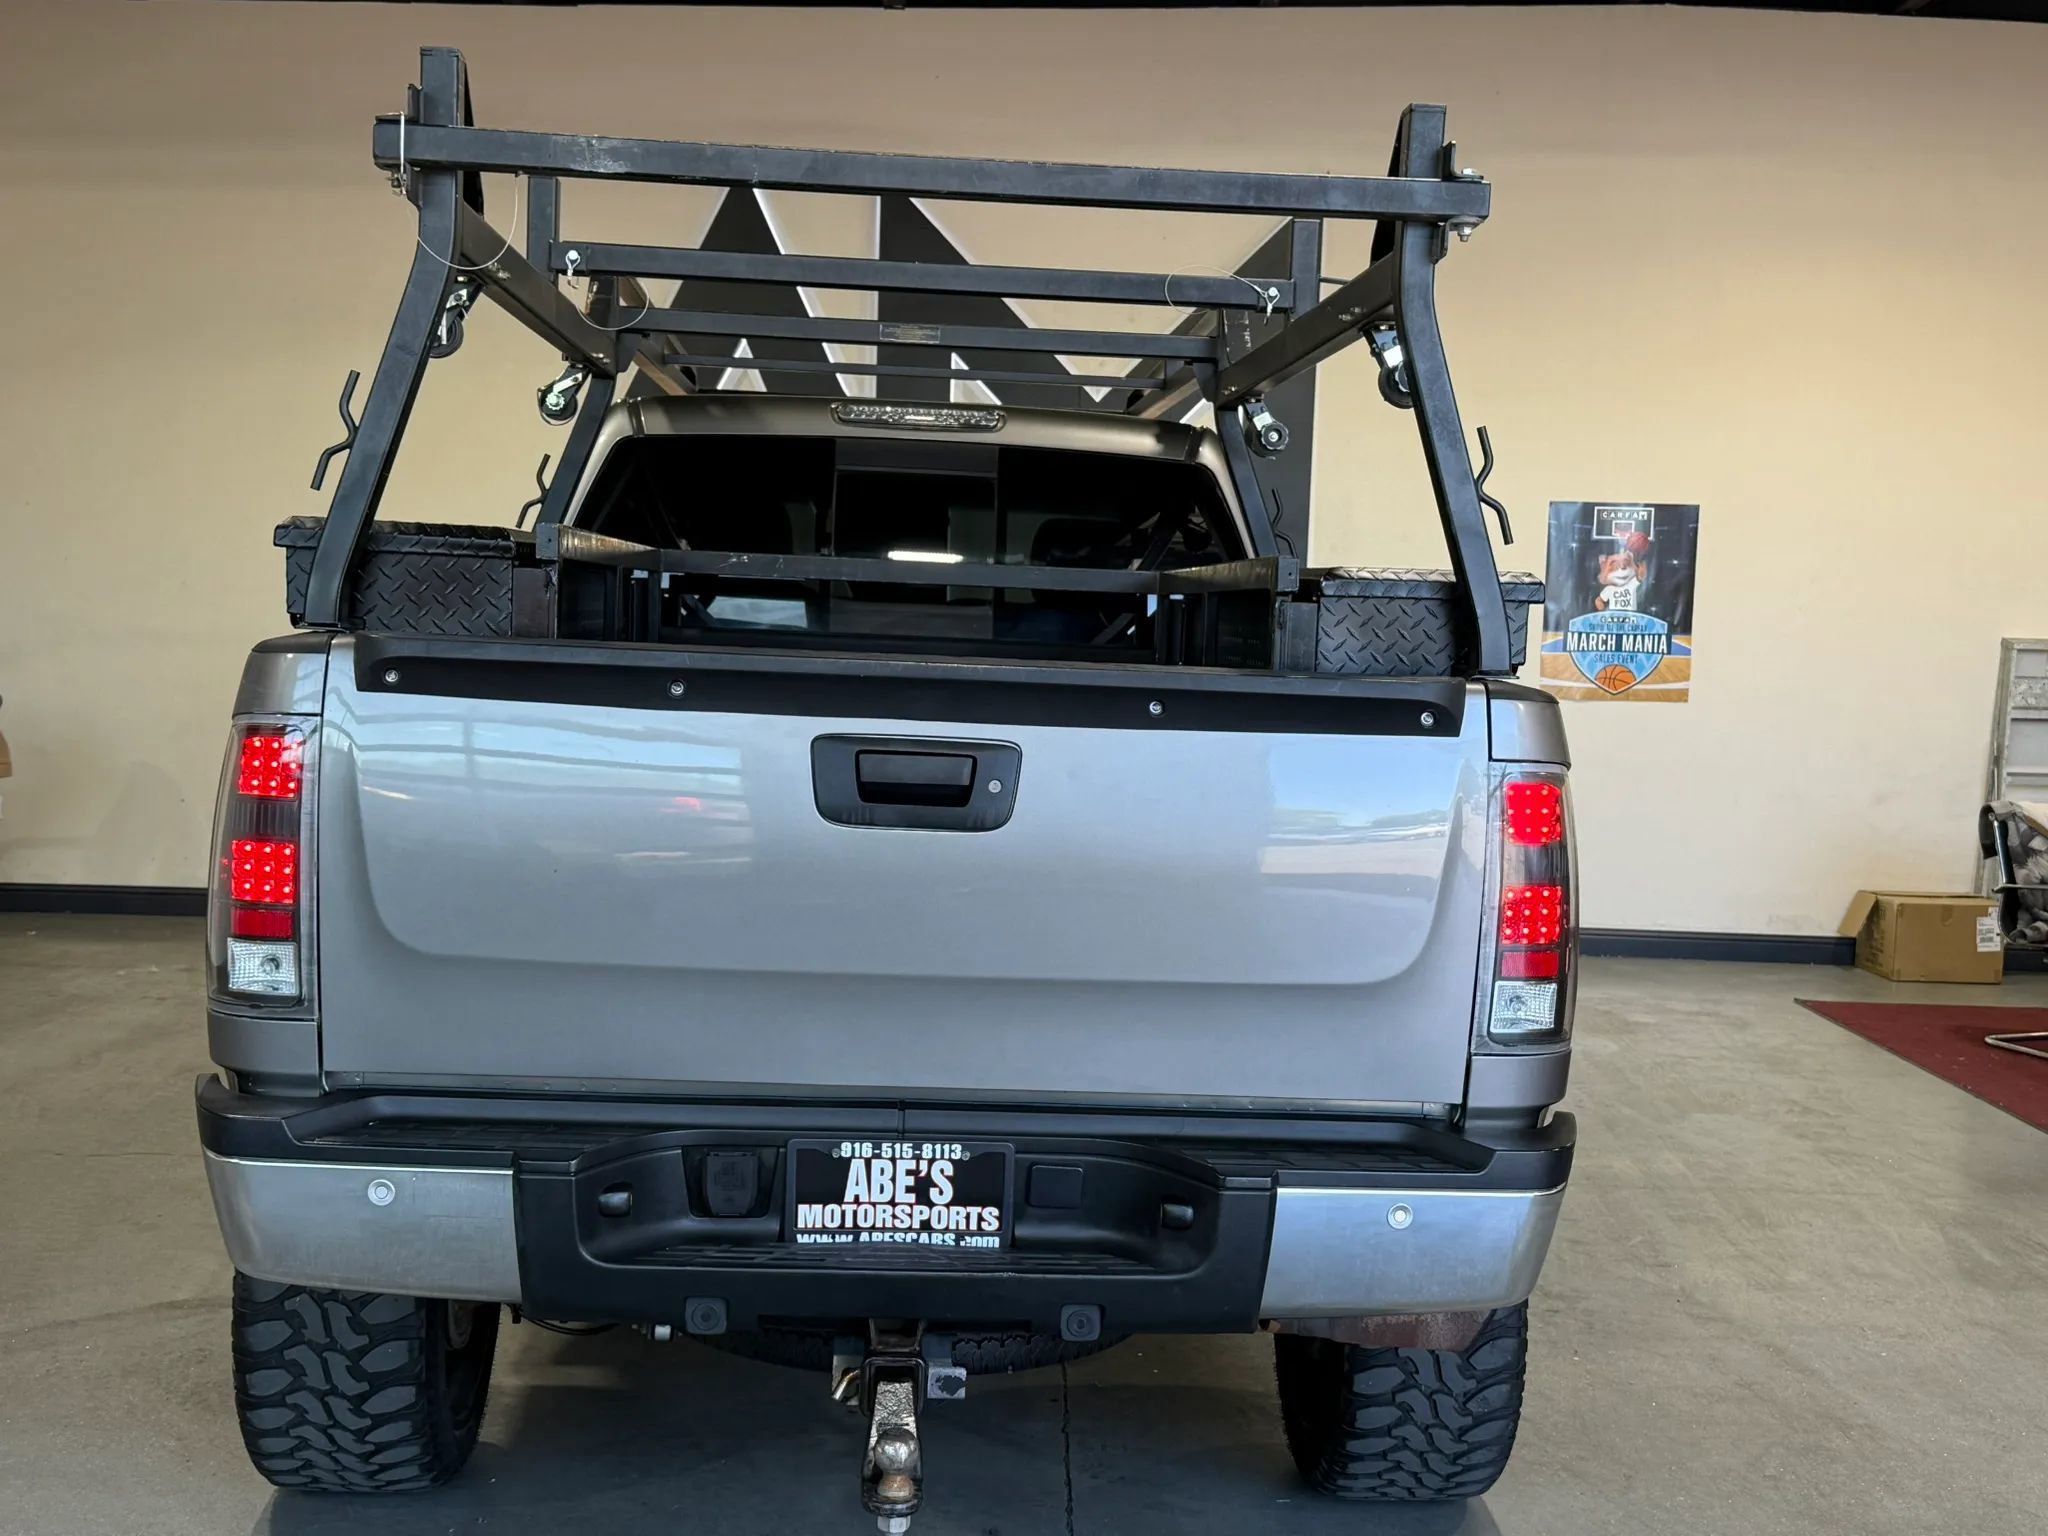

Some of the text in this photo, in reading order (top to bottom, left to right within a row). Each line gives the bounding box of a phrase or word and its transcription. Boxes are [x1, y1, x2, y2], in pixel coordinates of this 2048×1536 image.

[1613, 589, 1631, 599] CAR
[1614, 598, 1631, 608] FOX
[1566, 631, 1668, 654] MARCH MANIA
[1617, 654, 1639, 664] EVENT
[840, 1142, 962, 1160] 916-515-8113
[843, 1158, 955, 1205] ABE'S
[797, 1203, 1000, 1231] MOTORSPORTS
